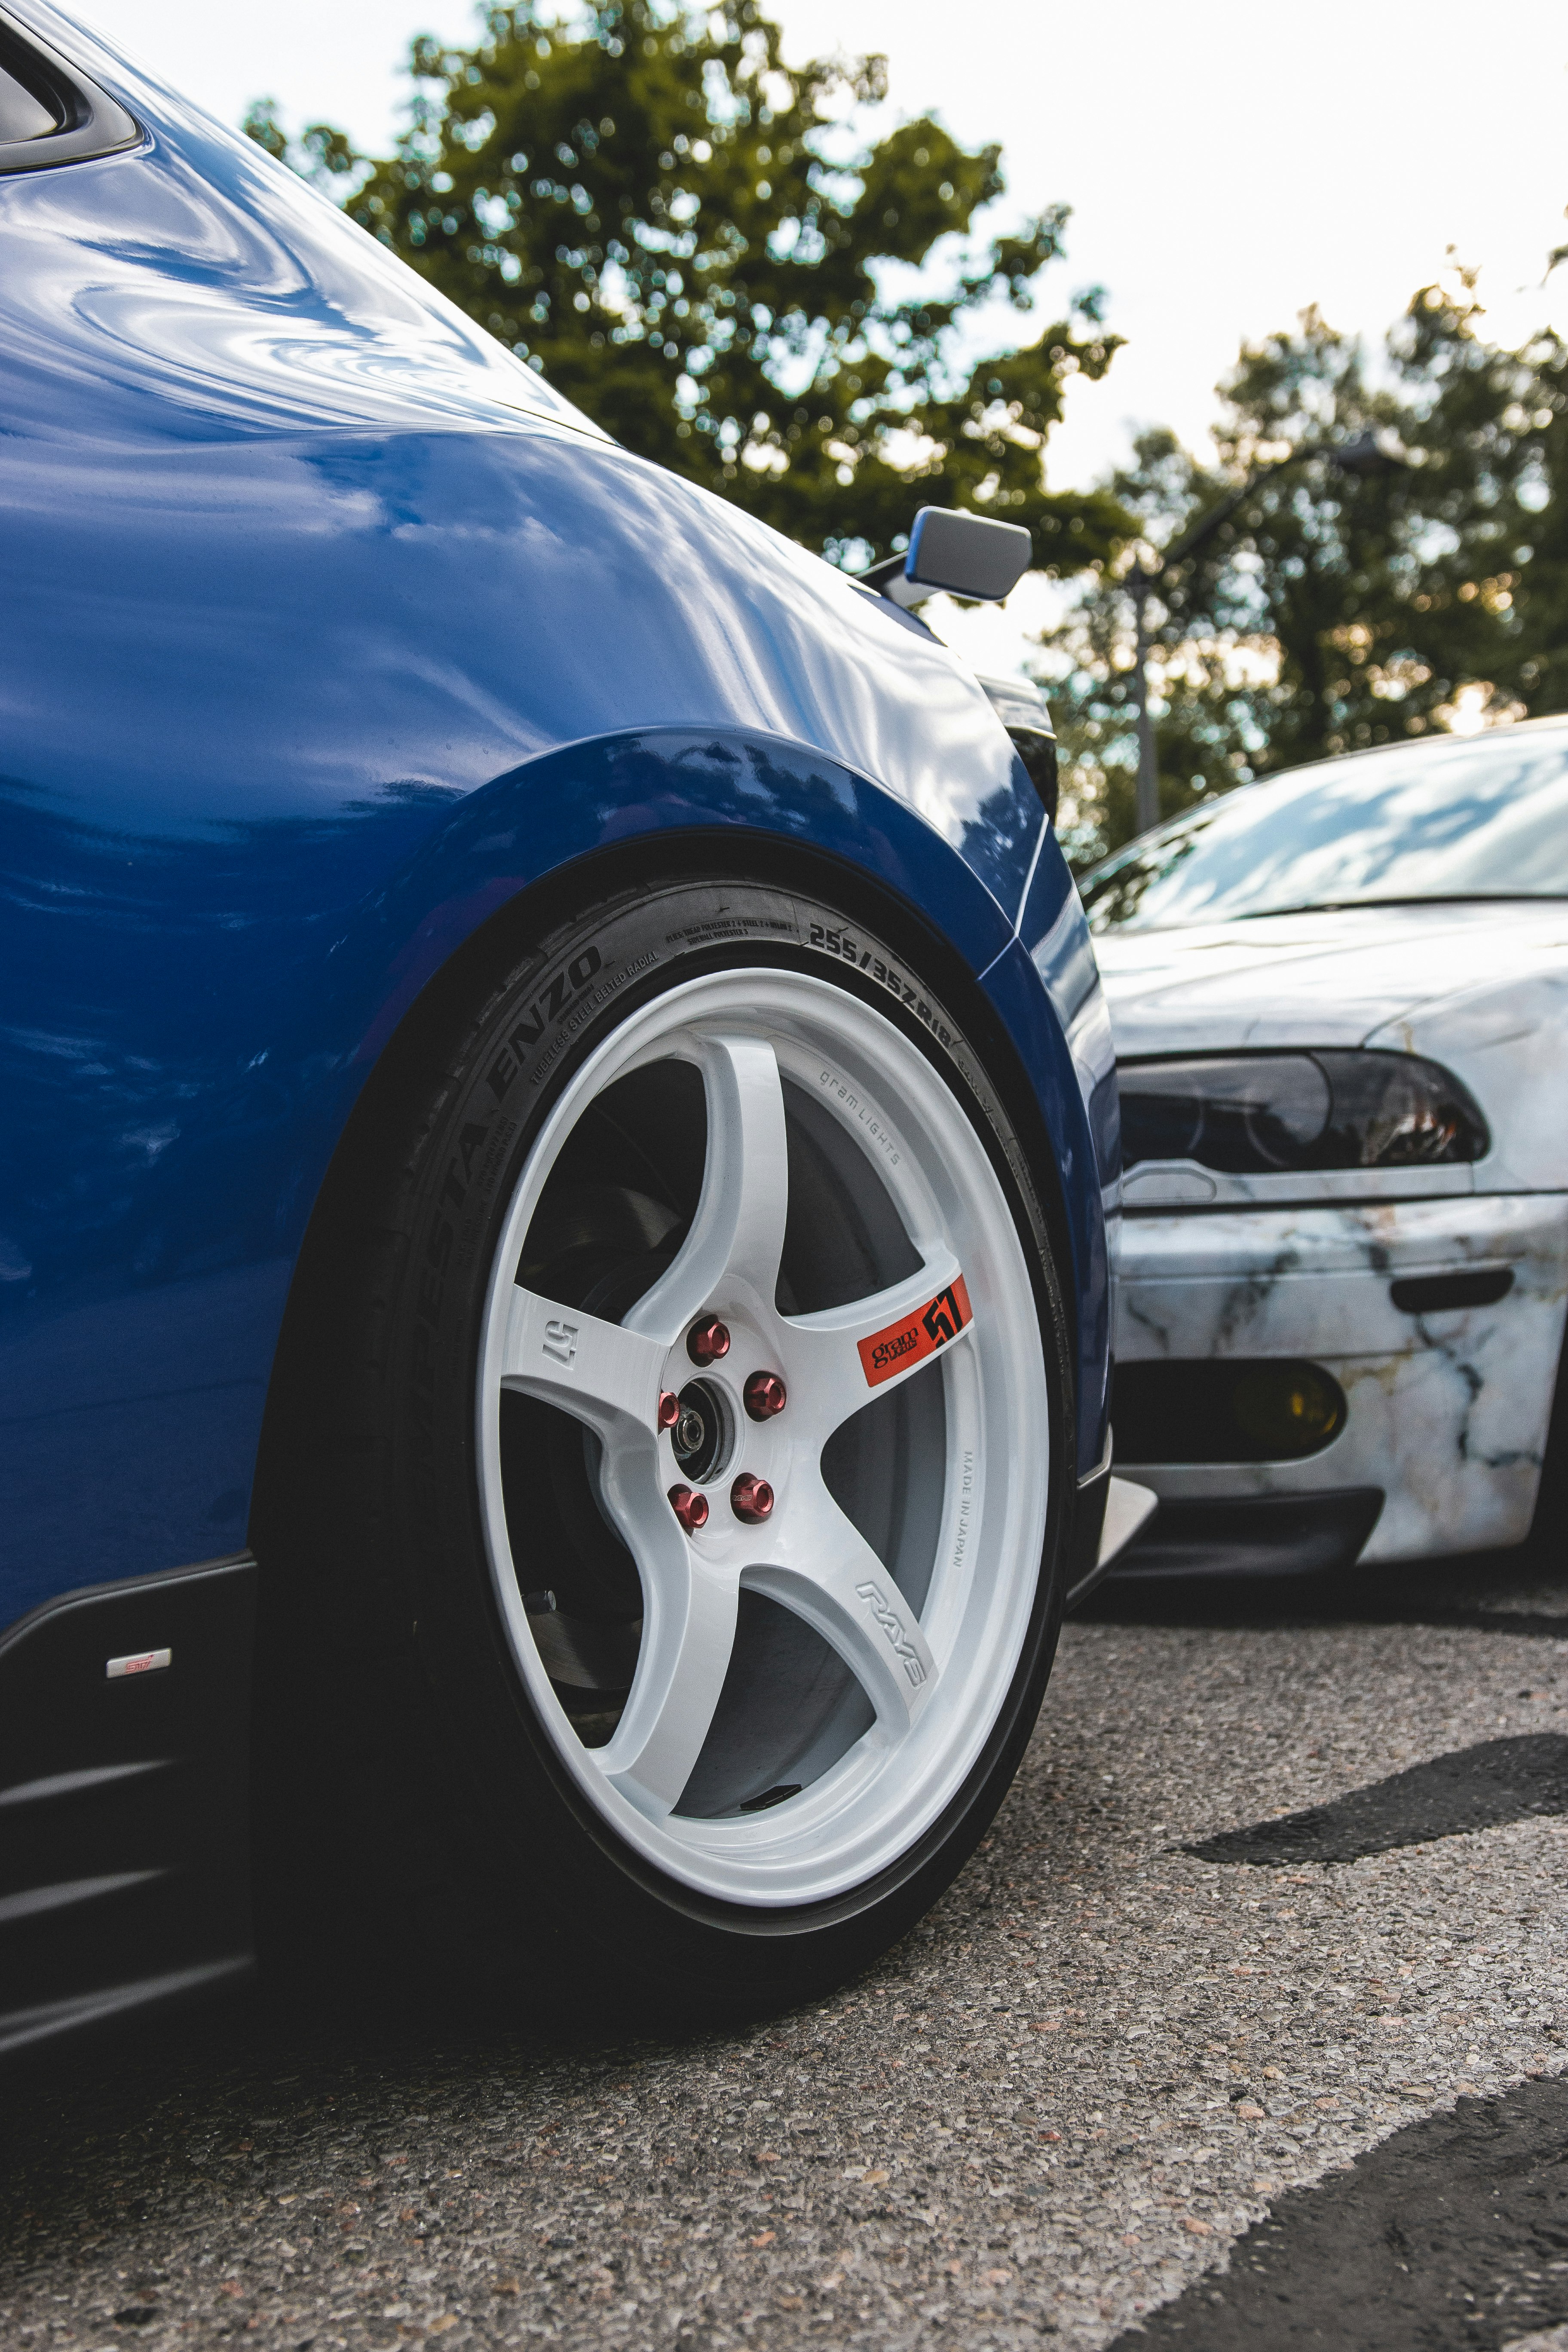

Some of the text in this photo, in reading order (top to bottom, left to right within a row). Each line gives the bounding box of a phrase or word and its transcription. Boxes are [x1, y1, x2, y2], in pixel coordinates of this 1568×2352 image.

[666, 931, 683, 943] PLIES:
[683, 926, 701, 936] TREAD
[701, 921, 730, 931] POLYESTER
[687, 932, 713, 944] SIDEWALL
[714, 928, 743, 938] POLYESTER
[486, 944, 603, 1102] ENZO
[530, 951, 659, 1085] TUBELESS STEEL BELTED RADIAL
[819, 1071, 899, 1165] gram LIGHTS
[542, 1320, 579, 1371] 57
[871, 1327, 919, 1369] gram
[922, 1285, 963, 1349] 57
[953, 1451, 973, 1568] MADE IN JAPAN
[855, 1581, 926, 1688] RAYS
